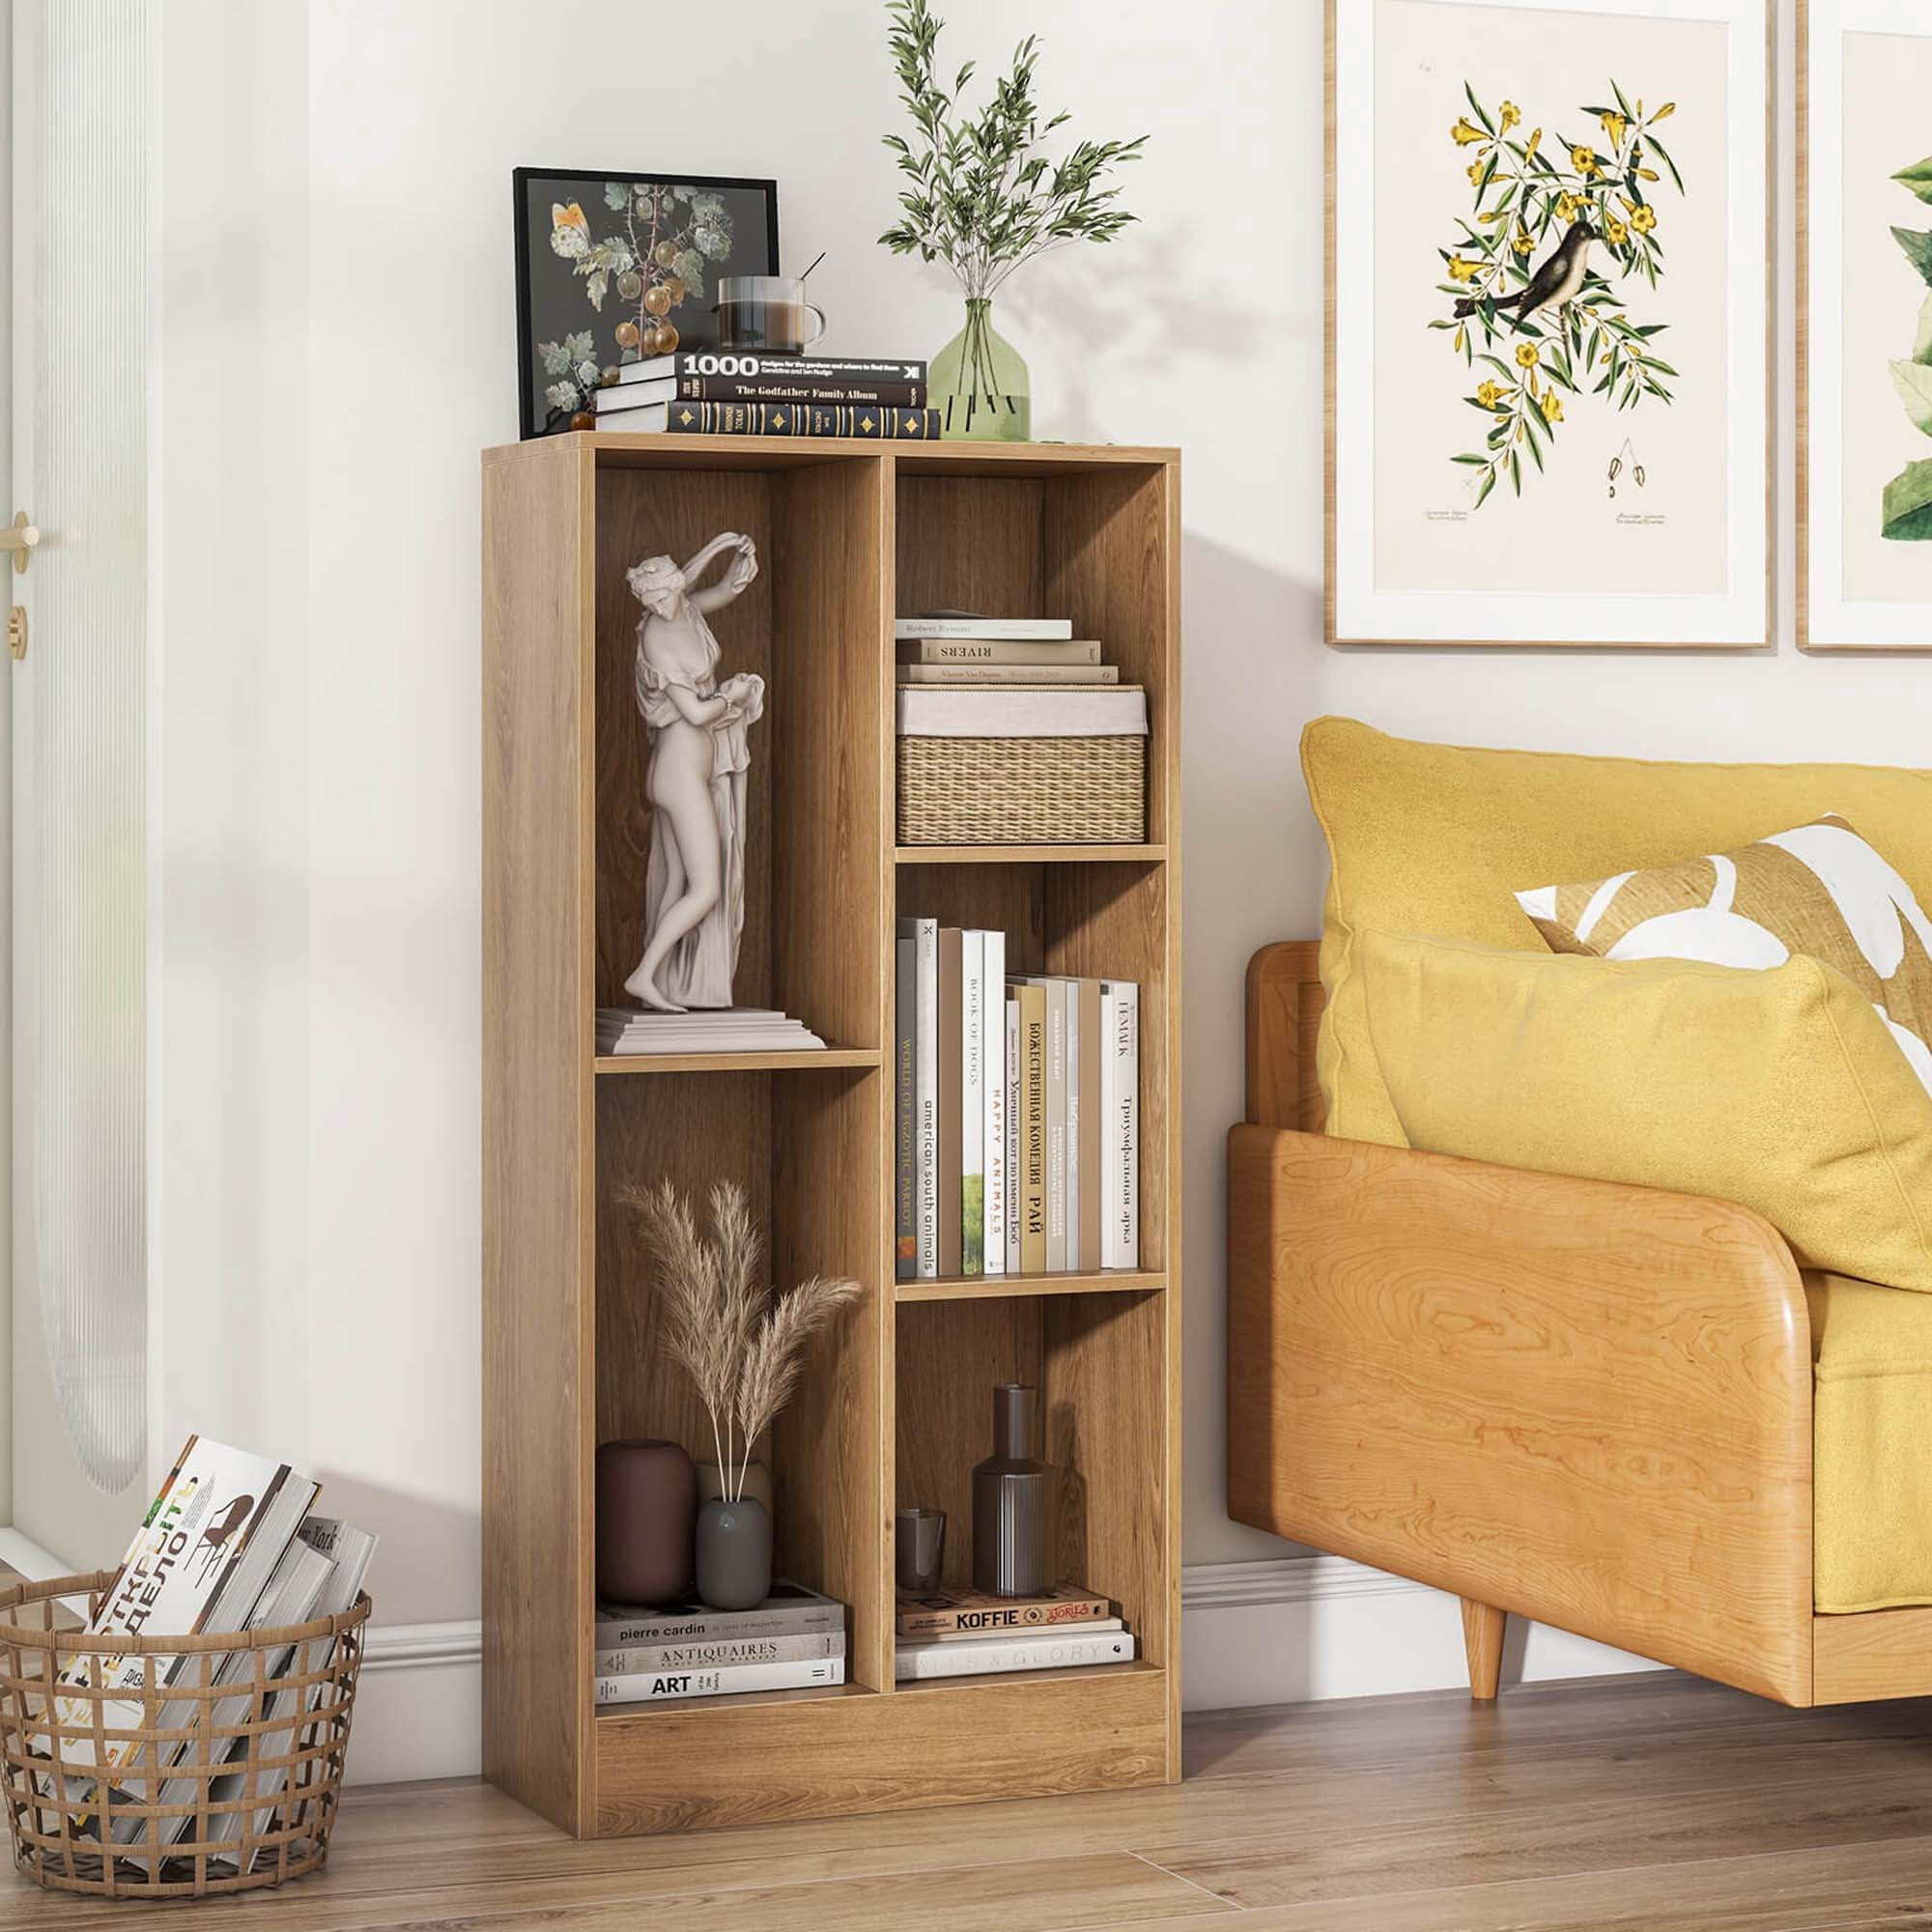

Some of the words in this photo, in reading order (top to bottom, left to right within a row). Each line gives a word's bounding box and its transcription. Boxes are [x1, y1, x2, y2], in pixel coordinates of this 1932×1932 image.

[683, 355, 758, 376] 1000
[735, 384, 755, 396] The
[758, 385, 809, 397] Godfather
[812, 387, 846, 400] Family
[847, 389, 877, 400] Album
[941, 647, 991, 658] RIVERS
[970, 978, 979, 1017] BOOK
[901, 1038, 912, 1086] WORLD
[1029, 1023, 1041, 1122] БОЖЕСТВЕННАЯ
[902, 1092, 912, 1107] OF
[993, 1090, 1002, 1144] HAPPY
[923, 1100, 935, 1166] american
[1121, 1095, 1133, 1205] Триумфальная
[1029, 1125, 1040, 1185] КОМЕДИЯ
[902, 1178, 913, 1228] PARROT
[923, 1171, 935, 1210] south
[993, 1158, 1002, 1235] ANIMALS
[1029, 1197, 1043, 1234] РАЙ
[1121, 1211, 1131, 1244] арка
[923, 1214, 935, 1270] animals
[312, 1525, 337, 1551] York
[124, 1529, 187, 1636] ДЕЛО
[619, 1627, 659, 1641] pierre
[664, 1623, 705, 1636] cardin
[956, 1609, 1019, 1630] KOFFIE
[661, 1642, 778, 1663] ANTIQUAIRES
[651, 1676, 692, 1694] ART
